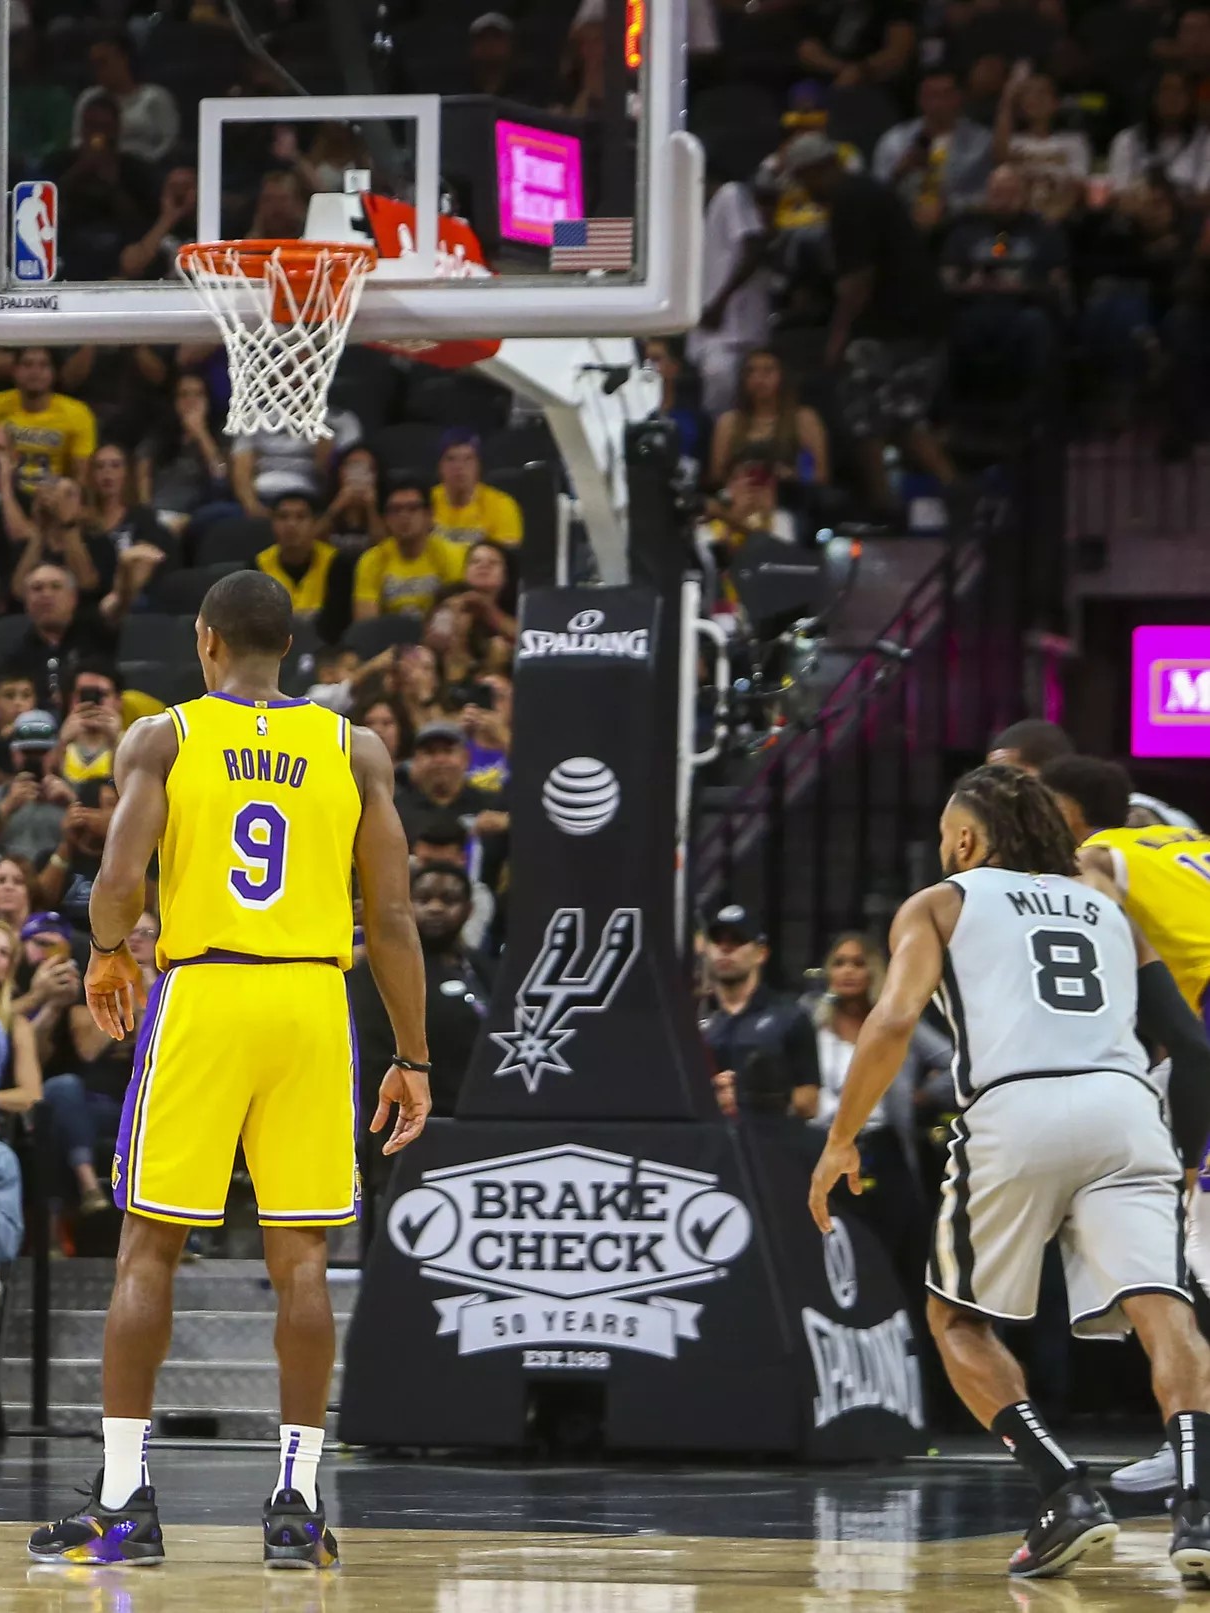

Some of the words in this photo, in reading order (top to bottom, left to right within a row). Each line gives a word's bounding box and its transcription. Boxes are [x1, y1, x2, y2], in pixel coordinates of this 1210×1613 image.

[518, 628, 649, 659] SPALDING
[223, 748, 308, 788] RONDO
[227, 800, 290, 911] 9
[1005, 891, 1101, 926] MILLS
[1025, 925, 1110, 1017] 8
[472, 1180, 669, 1221] BRAKE
[471, 1230, 666, 1272] CHECK
[492, 1313, 526, 1337] 50
[543, 1310, 640, 1338] YEARS
[802, 1306, 925, 1429] SPALDING
